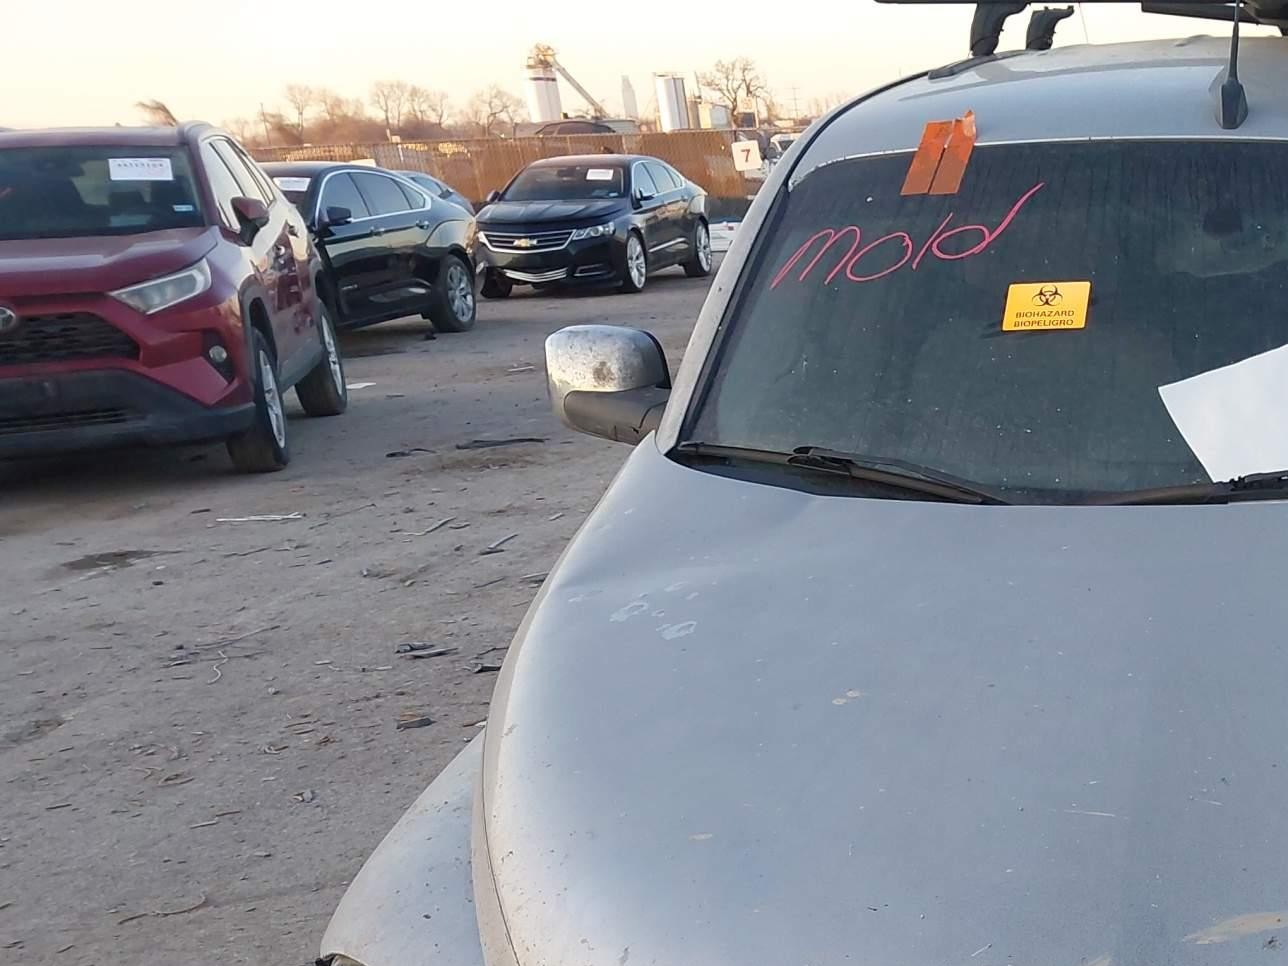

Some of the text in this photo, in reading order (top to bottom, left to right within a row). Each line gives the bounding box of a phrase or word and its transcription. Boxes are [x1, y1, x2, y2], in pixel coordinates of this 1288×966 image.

[740, 148, 751, 163] 7
[1015, 310, 1075, 319] BIOHAZARD
[1013, 319, 1074, 328] BIOPELIGRO
